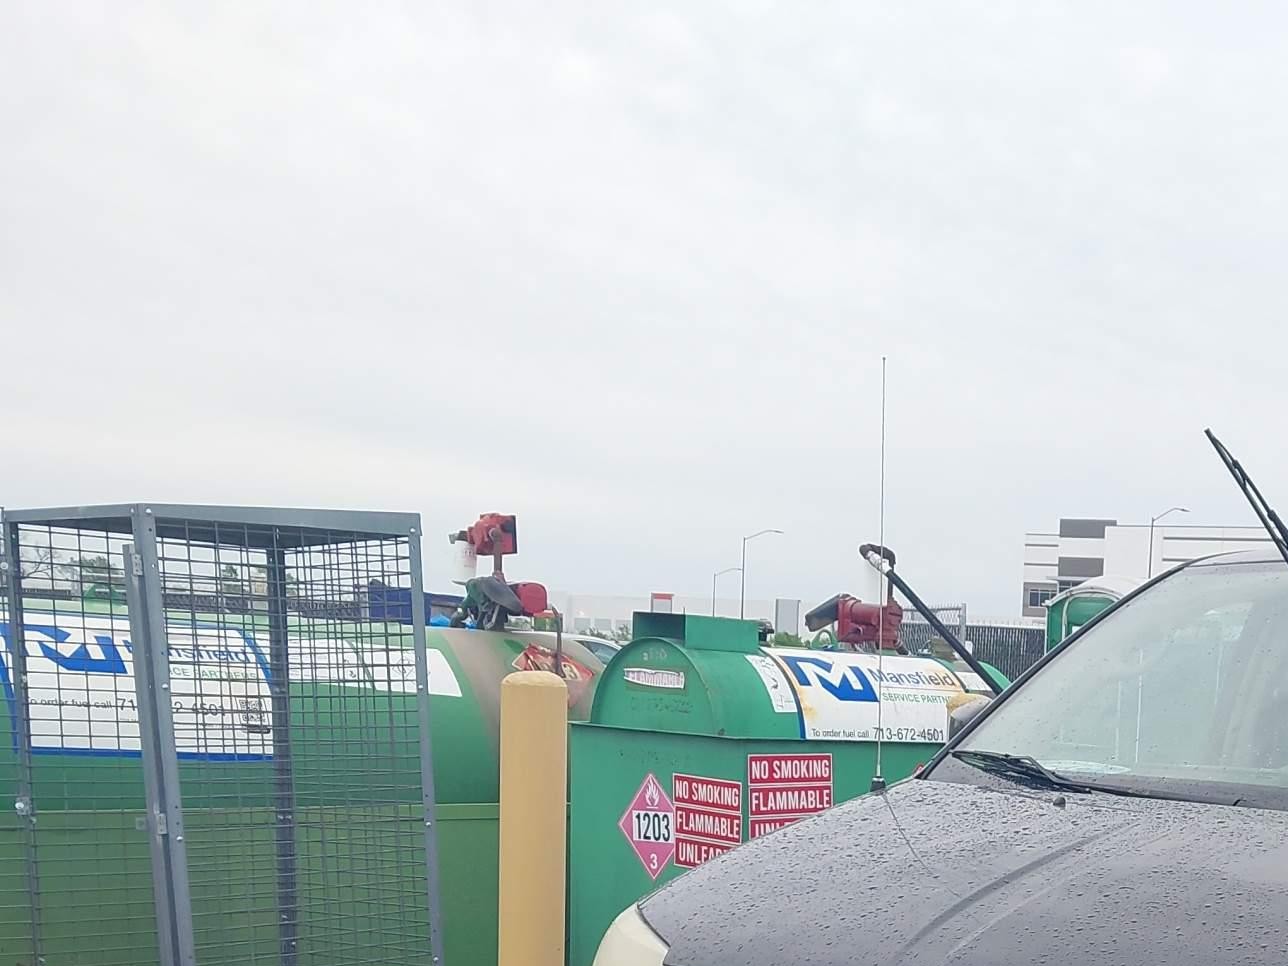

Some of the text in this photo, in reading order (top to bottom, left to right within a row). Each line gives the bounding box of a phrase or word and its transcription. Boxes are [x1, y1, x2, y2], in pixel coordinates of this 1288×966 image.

[867, 667, 957, 687] Mansfield
[882, 692, 951, 704] SERVICE PARTN
[812, 727, 944, 742] To order fuel call 713-672-4501
[751, 759, 830, 780] NO SMOKING
[675, 779, 739, 807] NO SMOKING
[751, 789, 830, 812] FLAMMABLE
[635, 812, 671, 842] 1203
[676, 810, 740, 839] FLAMMABLE
[650, 853, 658, 870] 3
